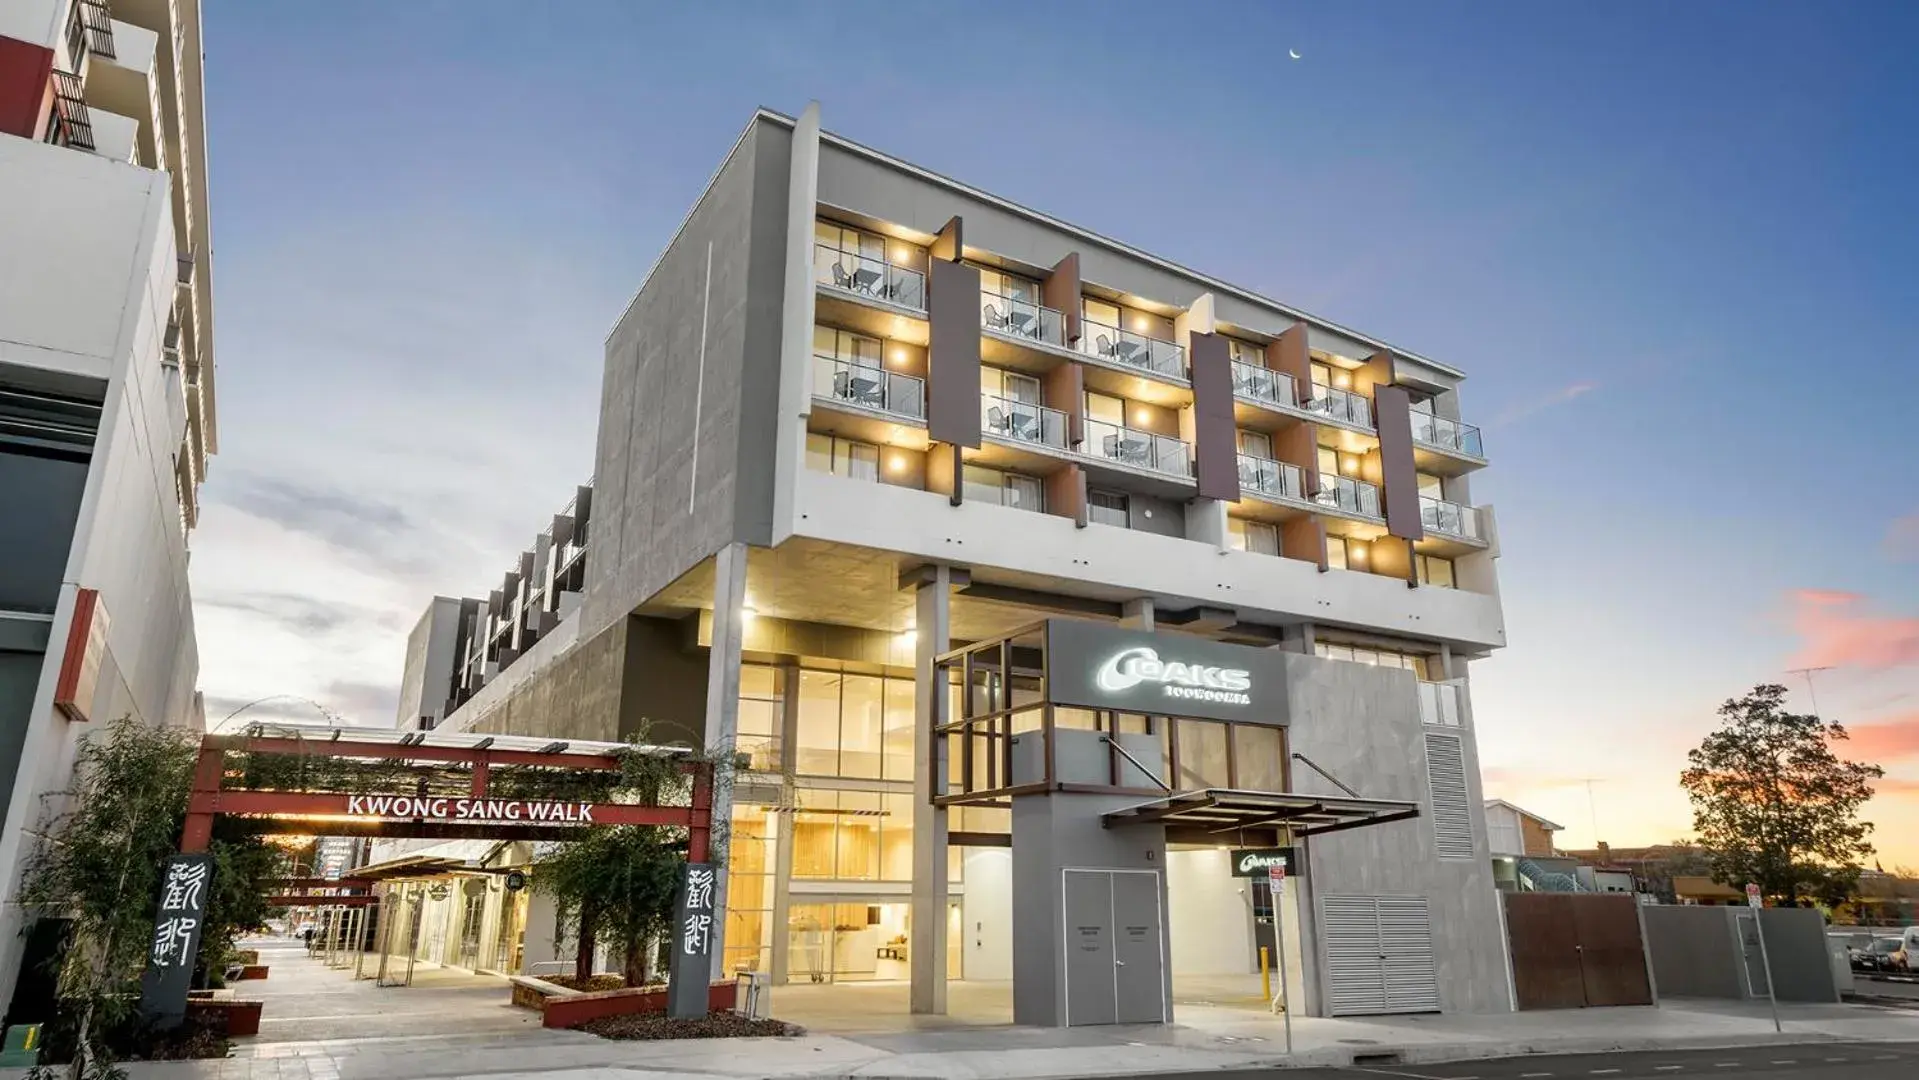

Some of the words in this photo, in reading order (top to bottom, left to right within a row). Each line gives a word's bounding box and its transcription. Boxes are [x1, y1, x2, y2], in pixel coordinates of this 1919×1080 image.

[347, 795, 448, 818] KWONG
[456, 800, 520, 820] SANG
[527, 802, 594, 822] WALK
